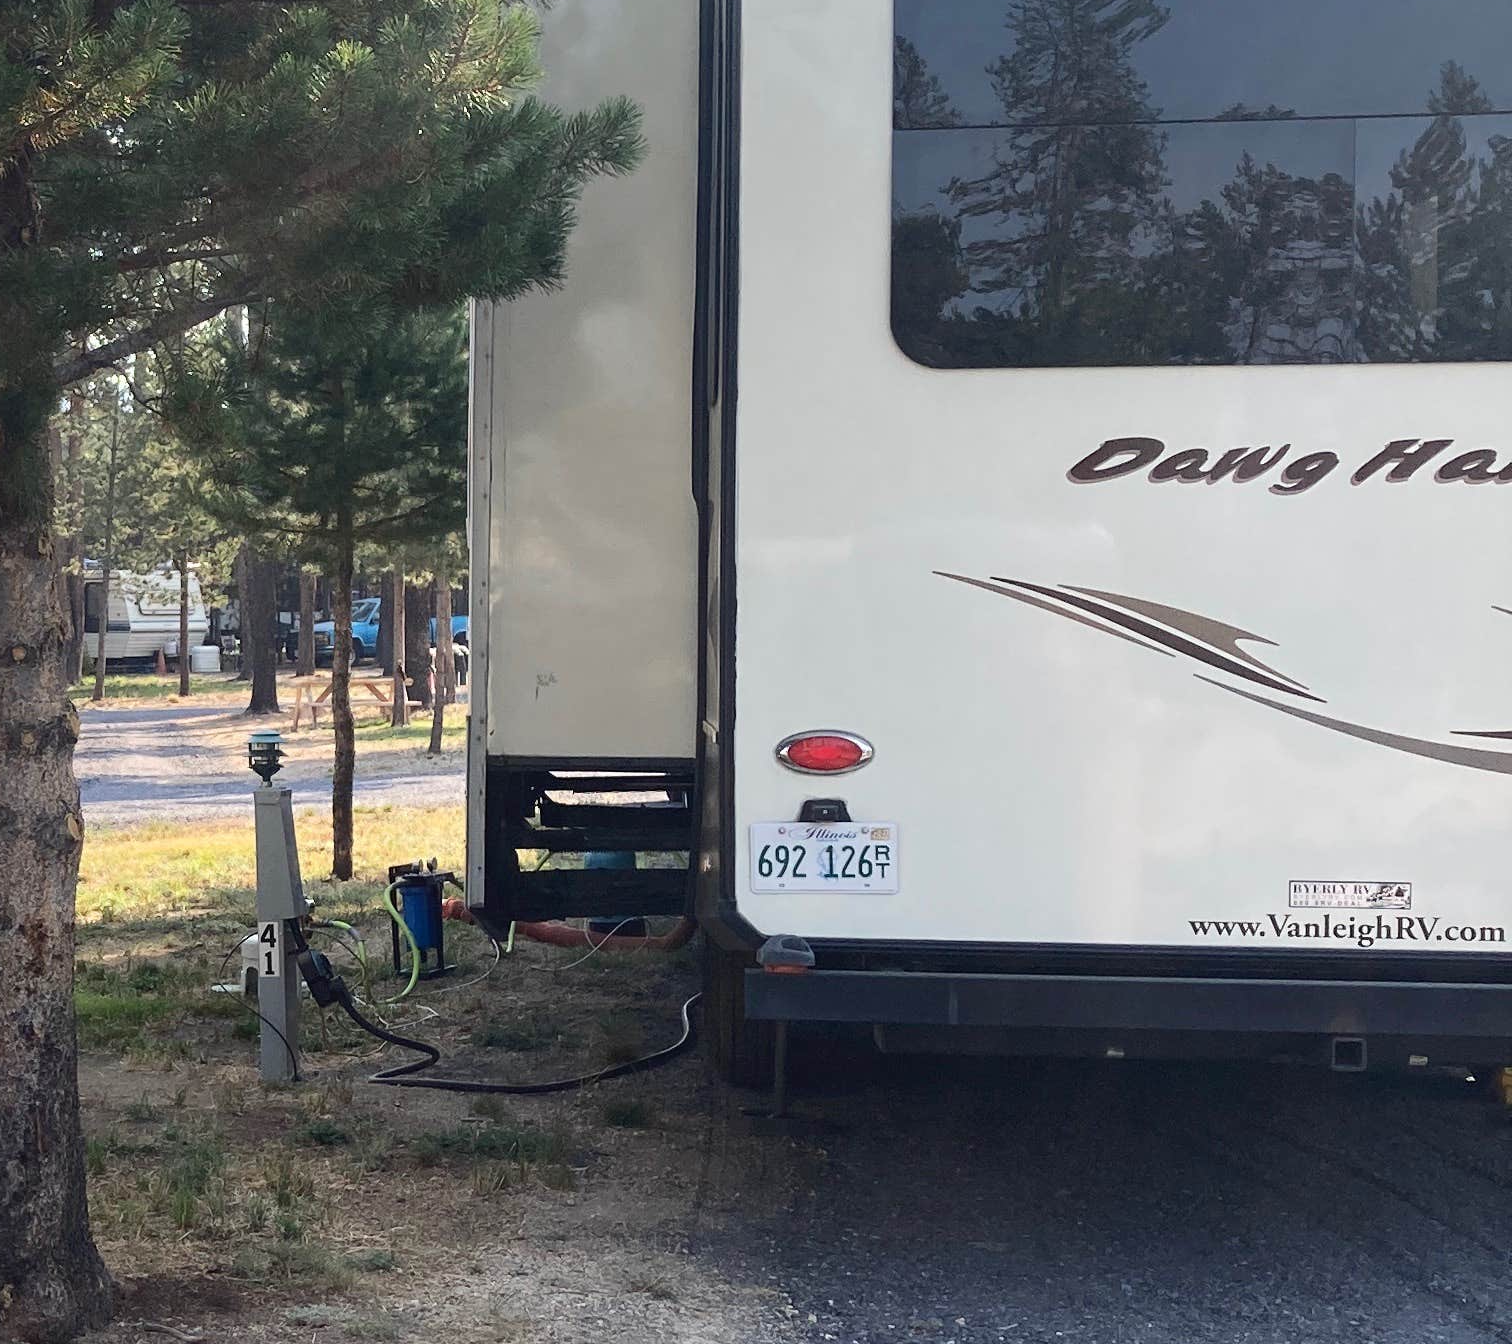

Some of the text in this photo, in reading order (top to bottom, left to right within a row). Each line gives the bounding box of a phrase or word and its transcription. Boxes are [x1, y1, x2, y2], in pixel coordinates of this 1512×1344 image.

[1066, 437, 1512, 495] Dawg Ha
[799, 826, 858, 840] Illinois
[758, 845, 806, 878] 692
[824, 845, 873, 878] 126
[1293, 884, 1371, 895] BYERLY RV
[1188, 914, 1506, 948] www.VanleighRV.com
